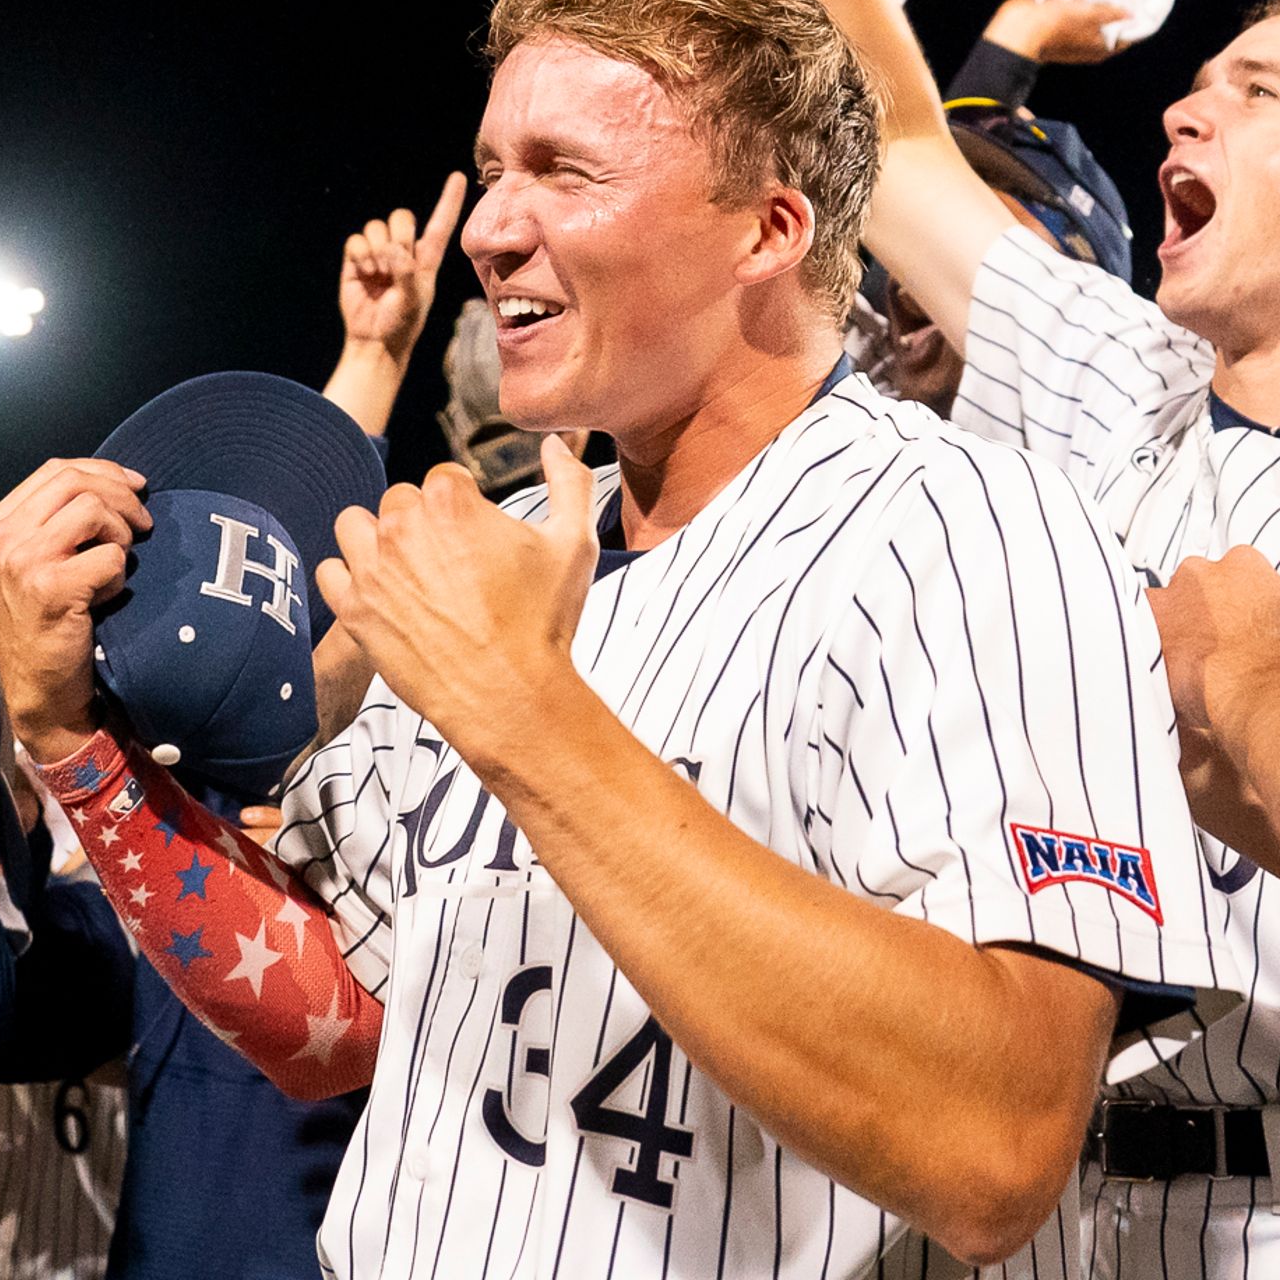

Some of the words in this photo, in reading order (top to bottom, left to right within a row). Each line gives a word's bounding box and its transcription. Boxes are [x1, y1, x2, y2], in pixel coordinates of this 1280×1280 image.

[200, 513, 304, 636] H
[1017, 829, 1157, 908] NAIA
[481, 965, 694, 1210] 34
